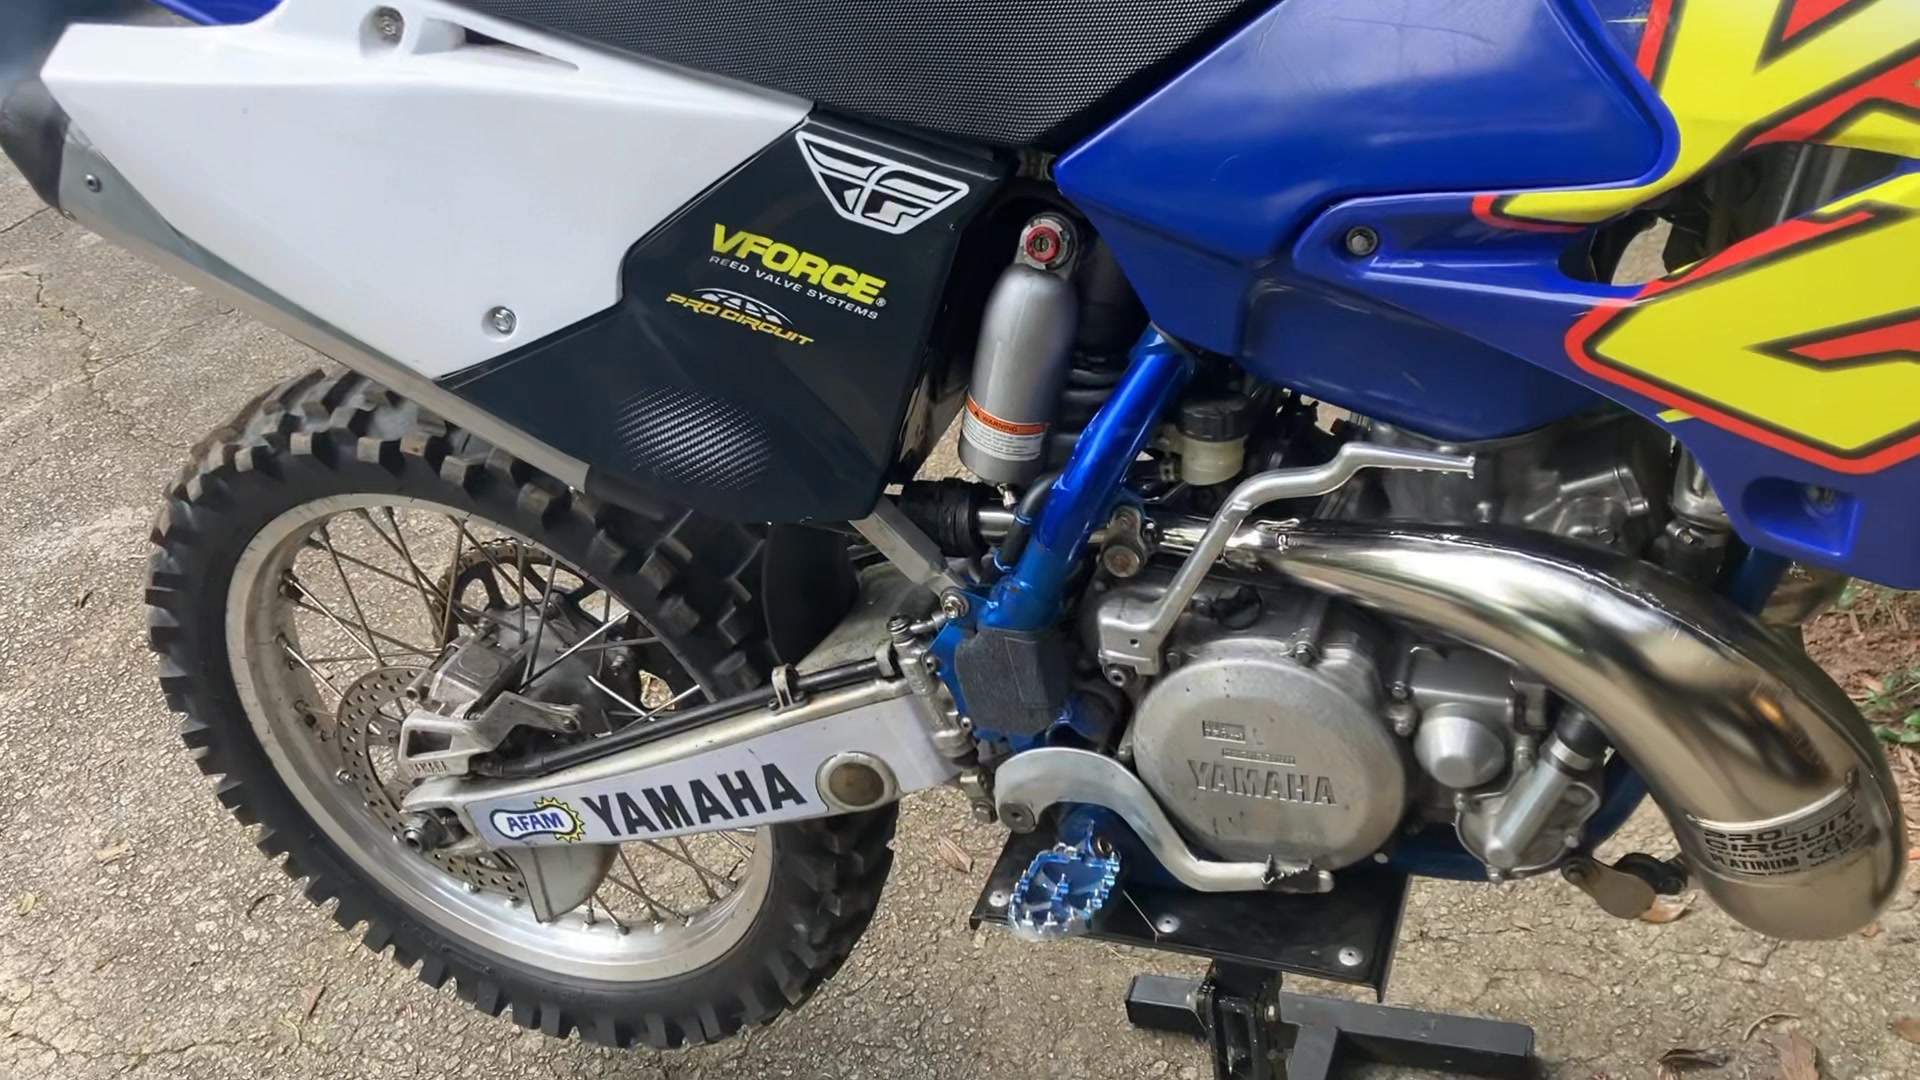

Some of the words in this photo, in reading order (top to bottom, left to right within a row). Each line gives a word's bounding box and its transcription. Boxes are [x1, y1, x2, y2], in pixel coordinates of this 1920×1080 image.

[709, 255, 750, 274] REED
[755, 270, 802, 293] VALVE
[806, 288, 880, 321] SYSTEMS
[665, 293, 720, 317] PRO
[720, 307, 815, 345] CIRCUIT
[982, 416, 1018, 433] WARNING
[580, 763, 808, 837] YAMAHA
[1187, 760, 1338, 806] YAMAHA
[506, 811, 565, 833] AFAM
[1705, 805, 1856, 853] CIRCUIT
[1710, 852, 1799, 871] PLATINUM
